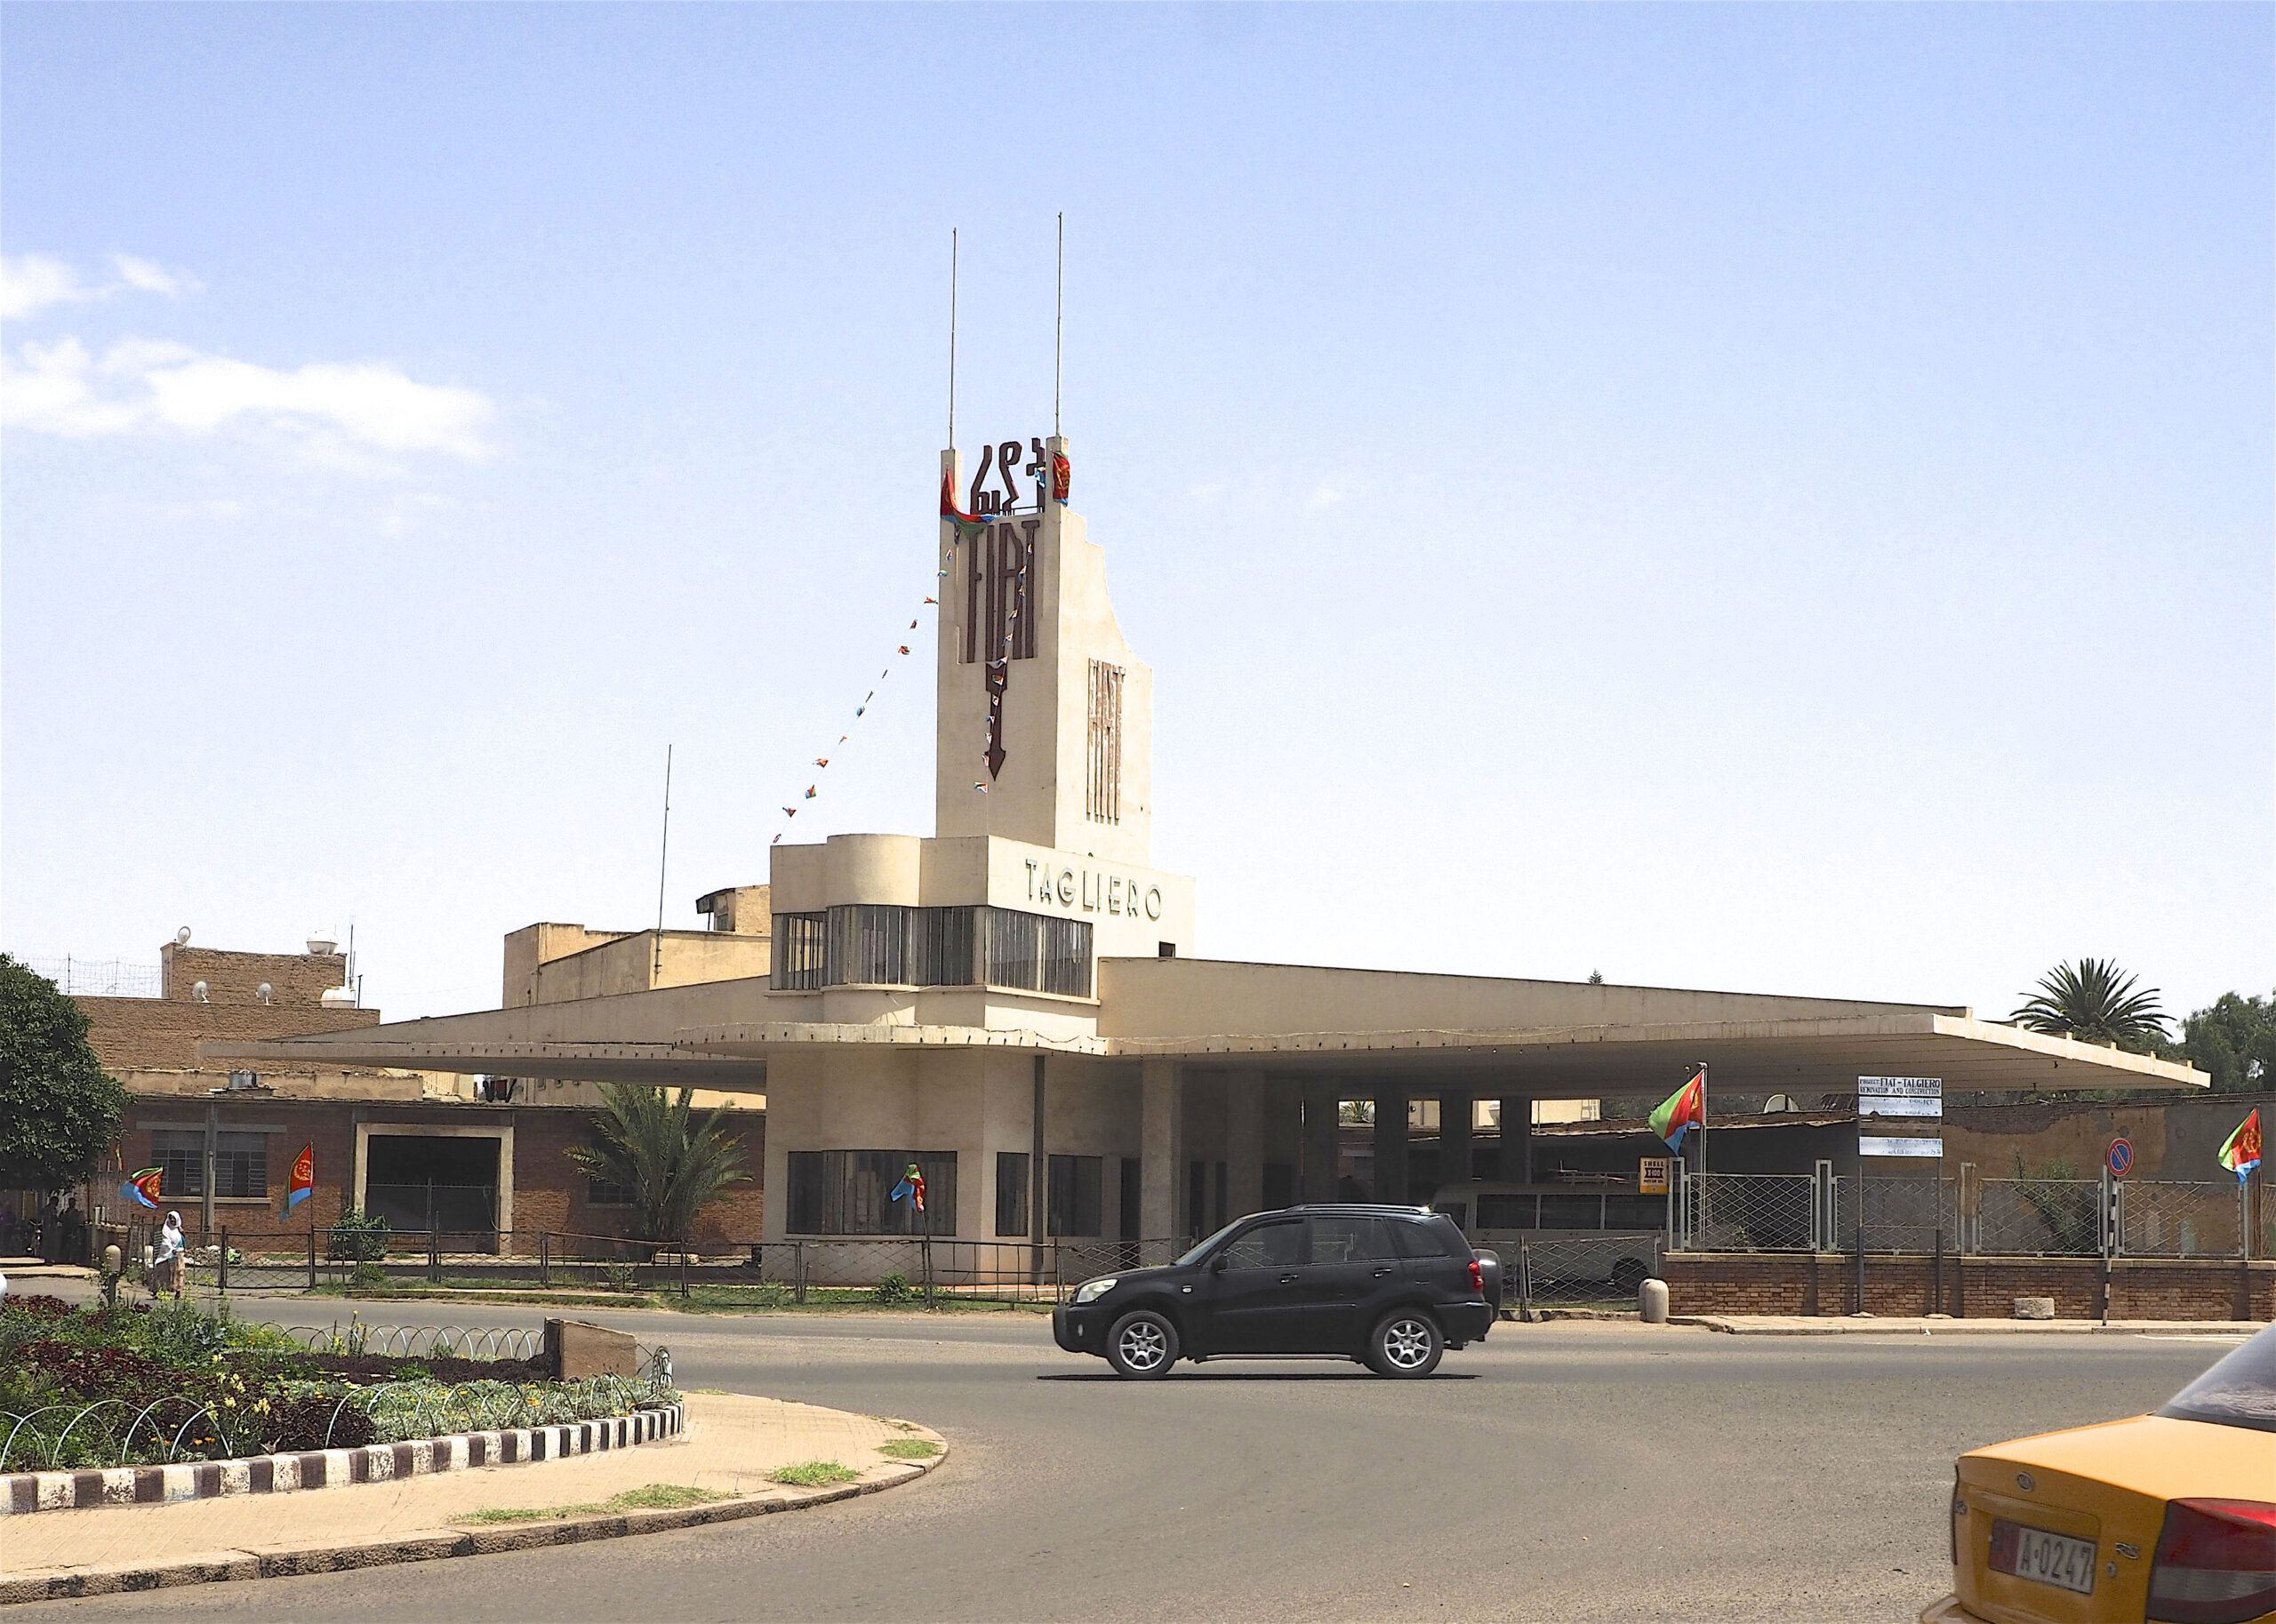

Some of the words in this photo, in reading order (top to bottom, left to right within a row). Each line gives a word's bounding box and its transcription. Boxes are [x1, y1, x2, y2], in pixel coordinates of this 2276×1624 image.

[966, 520, 1039, 664] FIAT
[1086, 658, 1126, 820] FIAT
[1025, 858, 1162, 921] TAGLIERO
